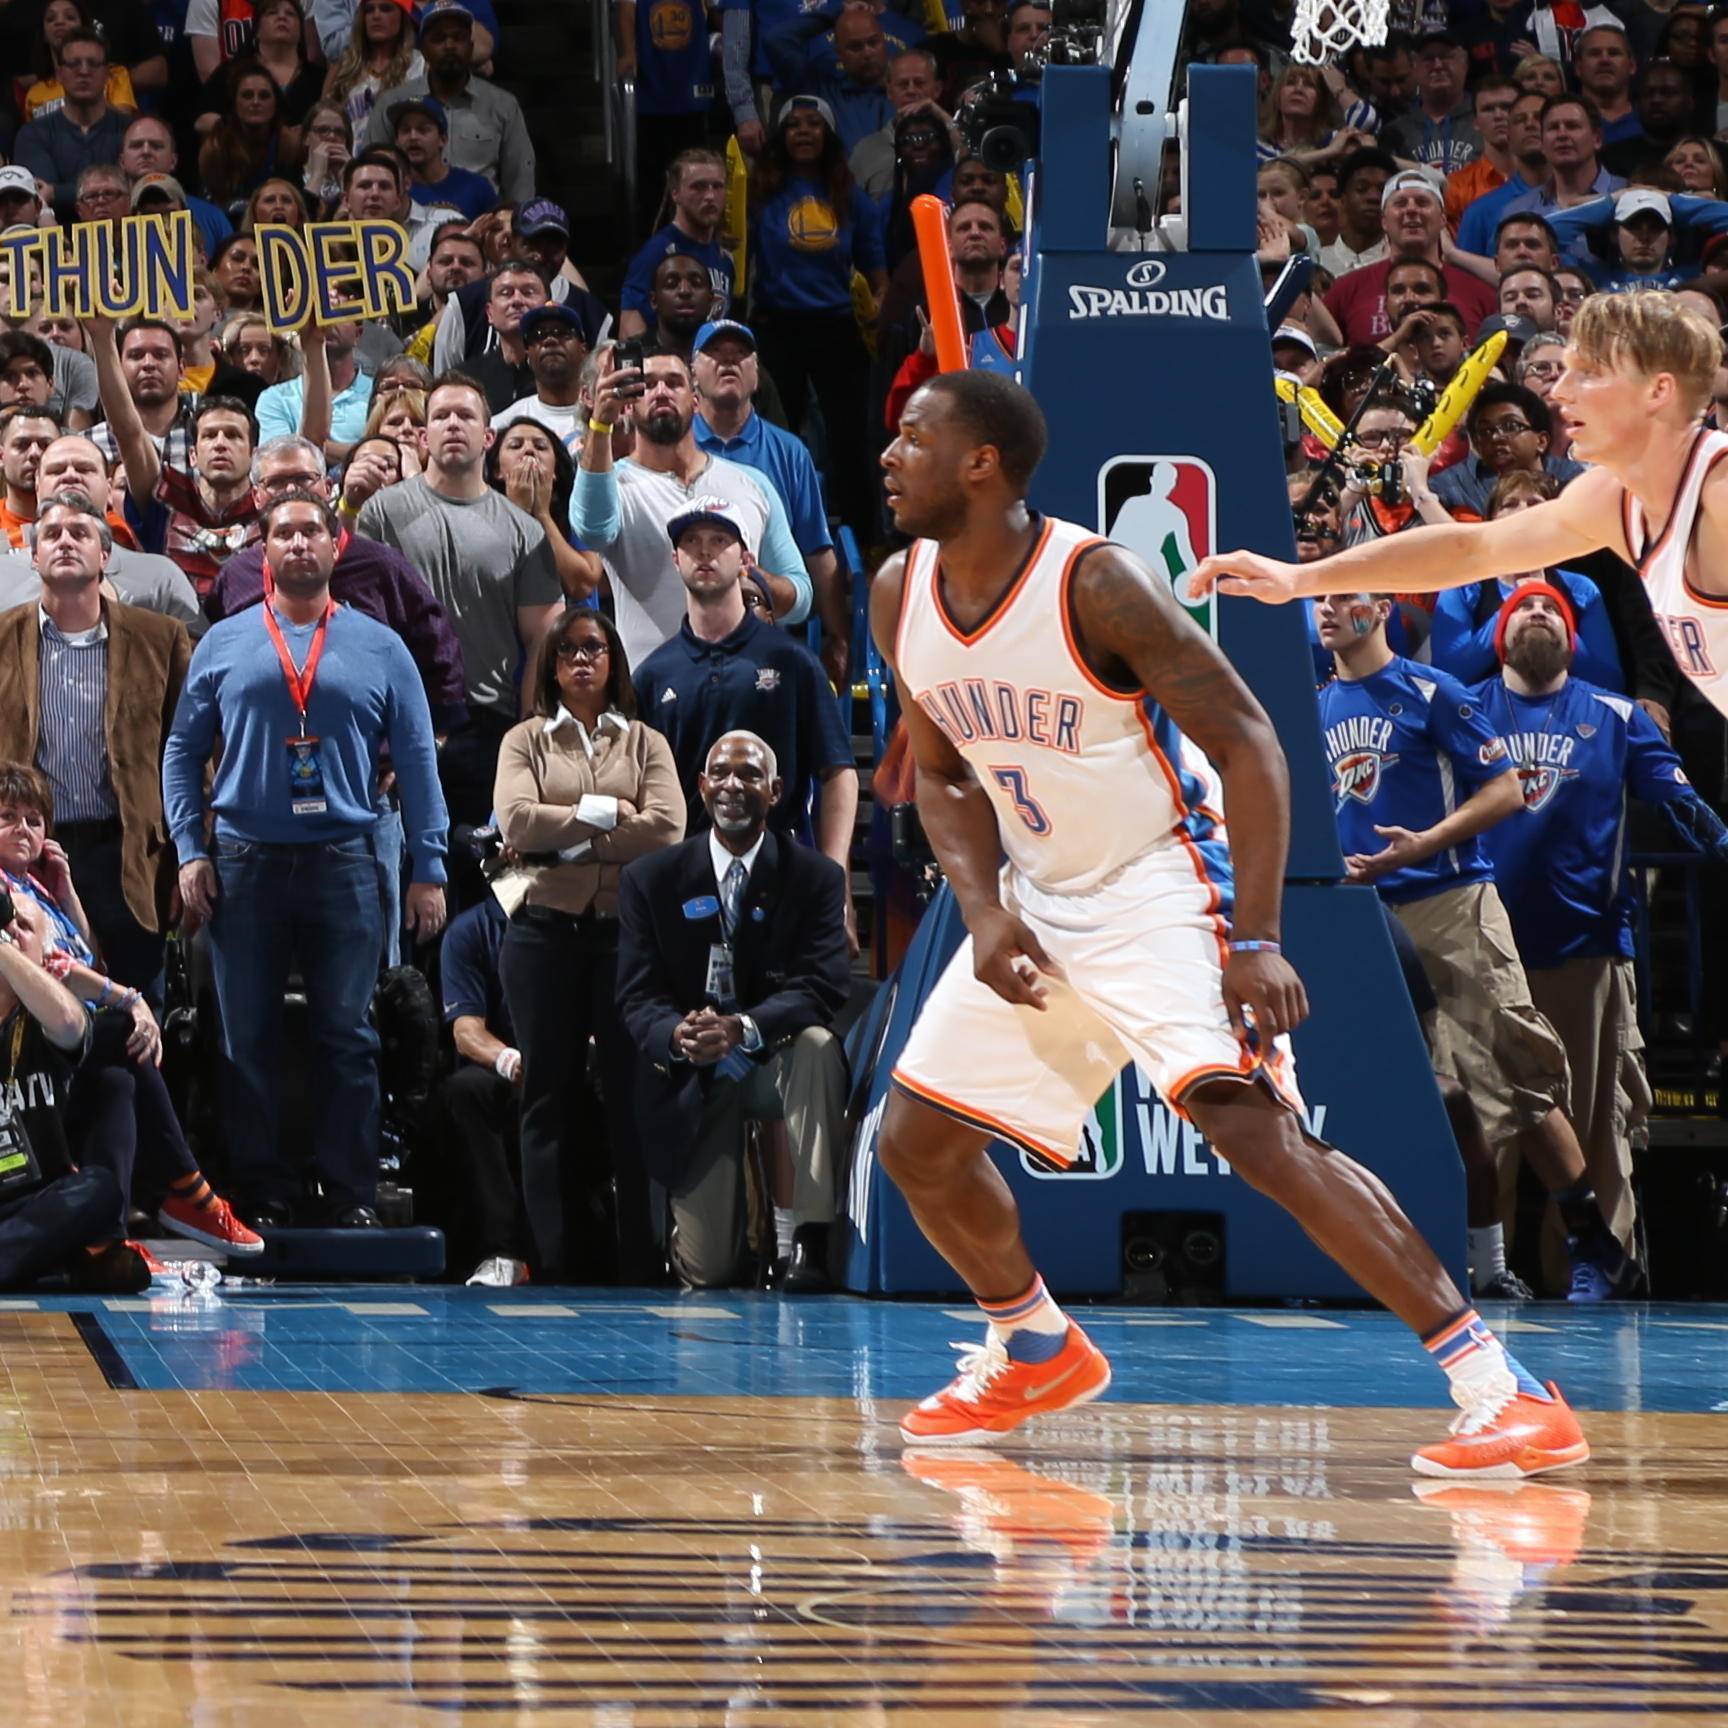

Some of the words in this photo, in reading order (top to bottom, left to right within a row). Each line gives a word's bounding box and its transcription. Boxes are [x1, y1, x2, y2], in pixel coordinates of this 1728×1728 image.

[254, 219, 417, 332] DER
[1068, 284, 1231, 322] SPALDING
[918, 677, 1084, 754] HUNDER
[988, 764, 1053, 838] 3
